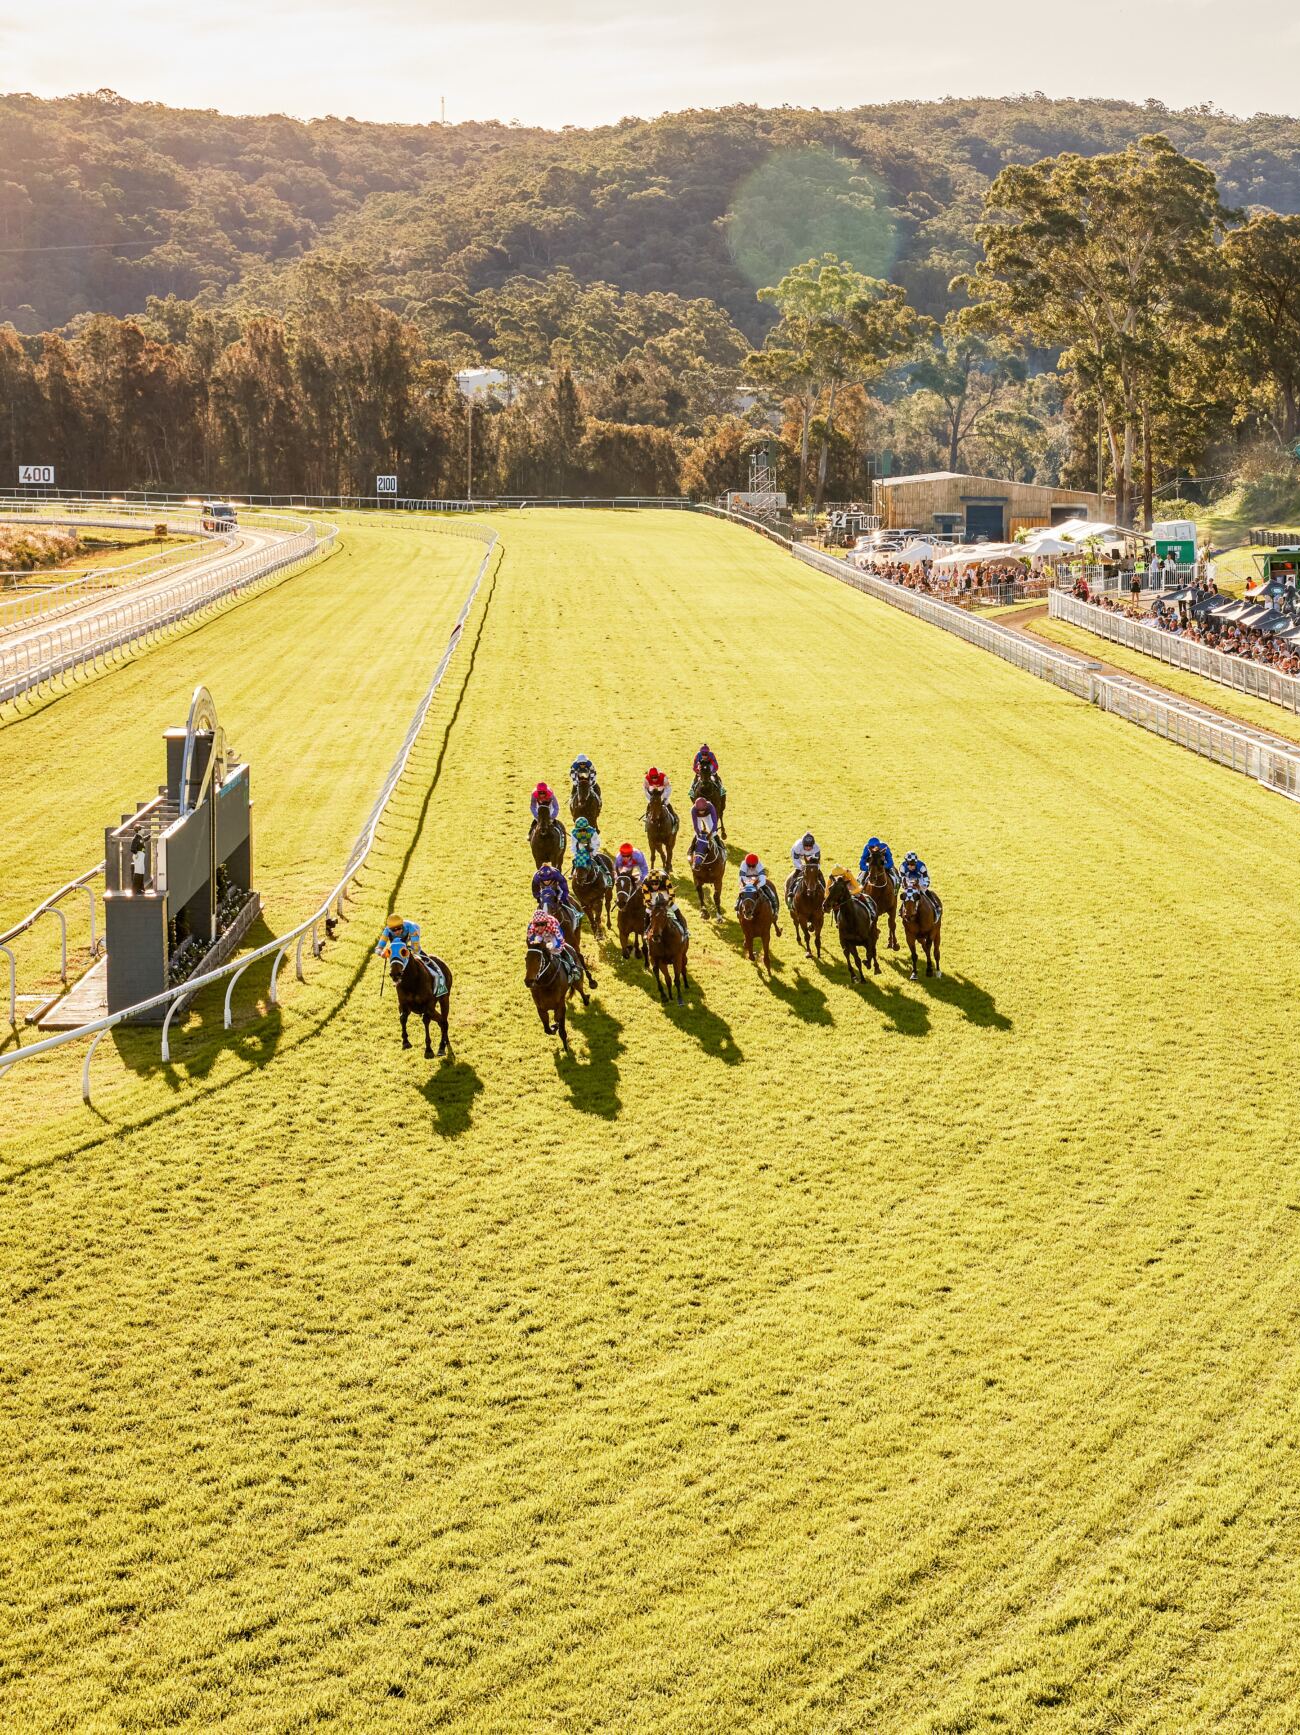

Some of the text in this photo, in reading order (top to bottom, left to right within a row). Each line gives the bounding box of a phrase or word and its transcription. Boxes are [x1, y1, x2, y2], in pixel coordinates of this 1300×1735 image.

[23, 467, 51, 482] 400
[378, 477, 396, 491] 2100
[834, 512, 843, 526] 2
[860, 516, 879, 529] 1900
